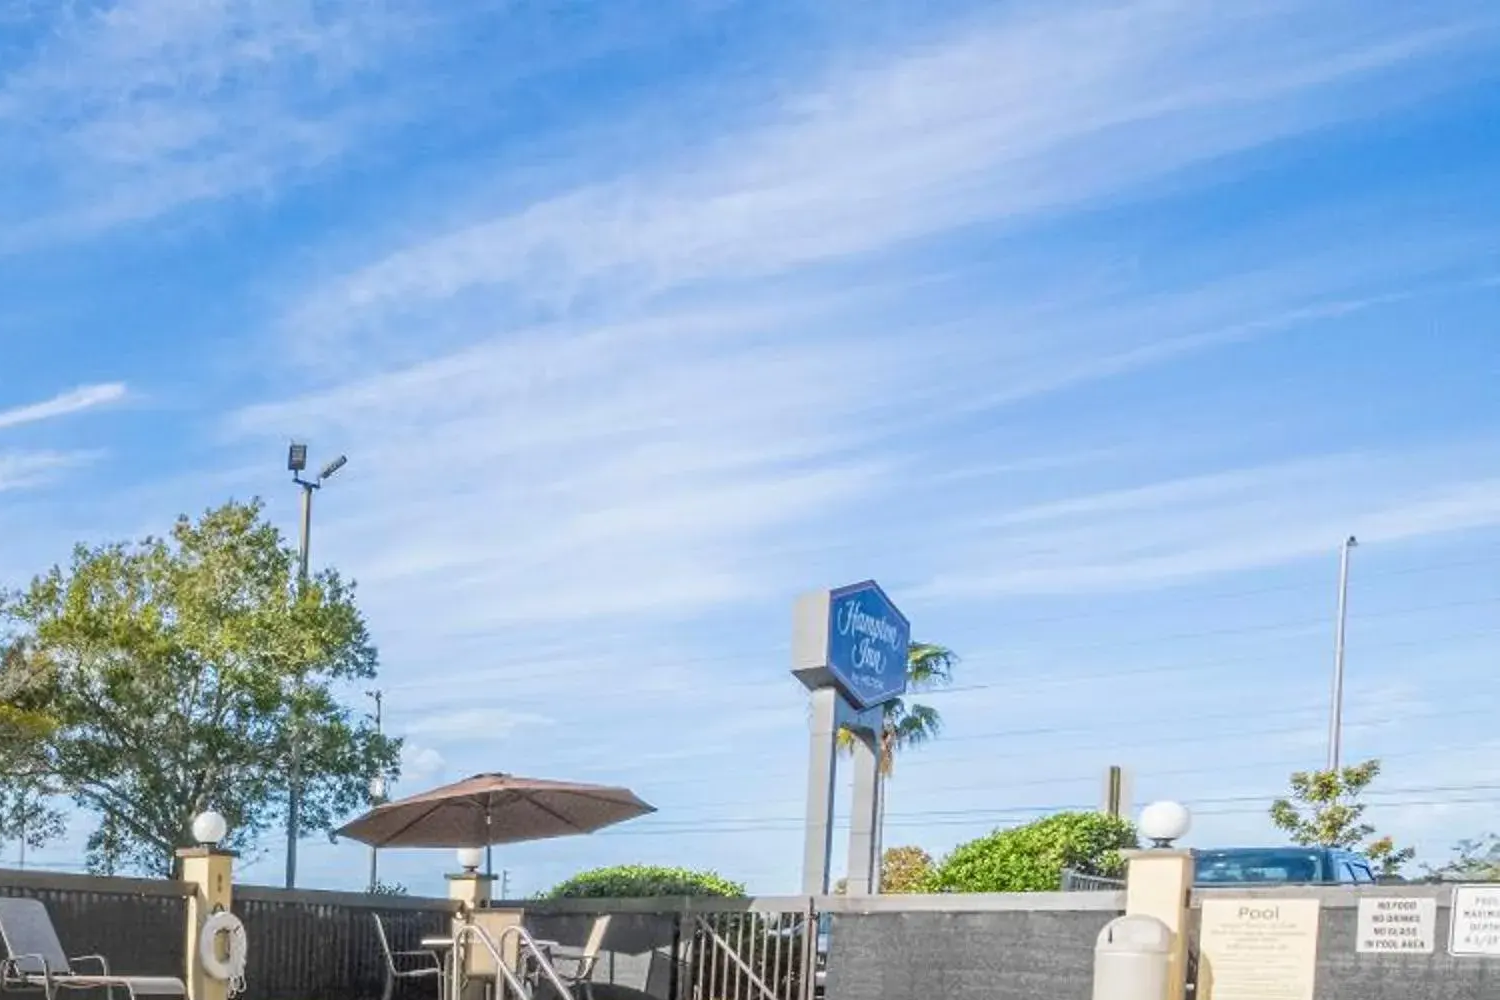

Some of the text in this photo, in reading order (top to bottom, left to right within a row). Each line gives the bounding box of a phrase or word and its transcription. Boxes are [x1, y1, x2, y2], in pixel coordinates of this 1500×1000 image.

[837, 600, 900, 649] Hampton
[851, 638, 887, 673] Inn
[1238, 906, 1280, 919] Pool
[1373, 927, 1386, 935] NO
